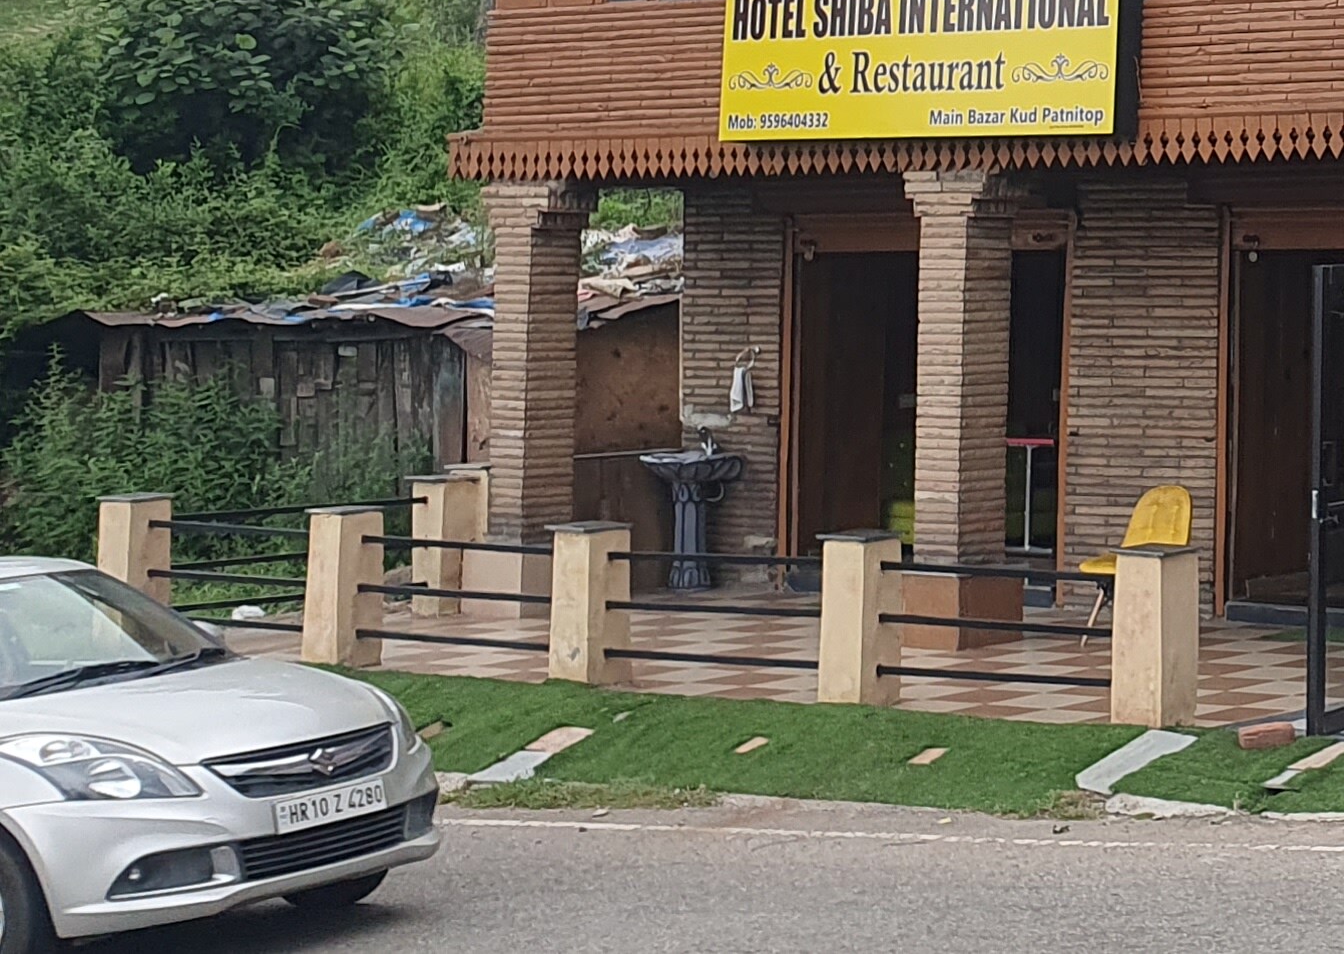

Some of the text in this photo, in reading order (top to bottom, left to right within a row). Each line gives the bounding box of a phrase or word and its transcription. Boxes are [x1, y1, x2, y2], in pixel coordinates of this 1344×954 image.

[818, 49, 1006, 94] & Restaurant
[728, 112, 829, 129] Mob: 9596404332
[929, 106, 1104, 126] Main Bazar Kud Patnitop
[348, 785, 383, 808] 4280
